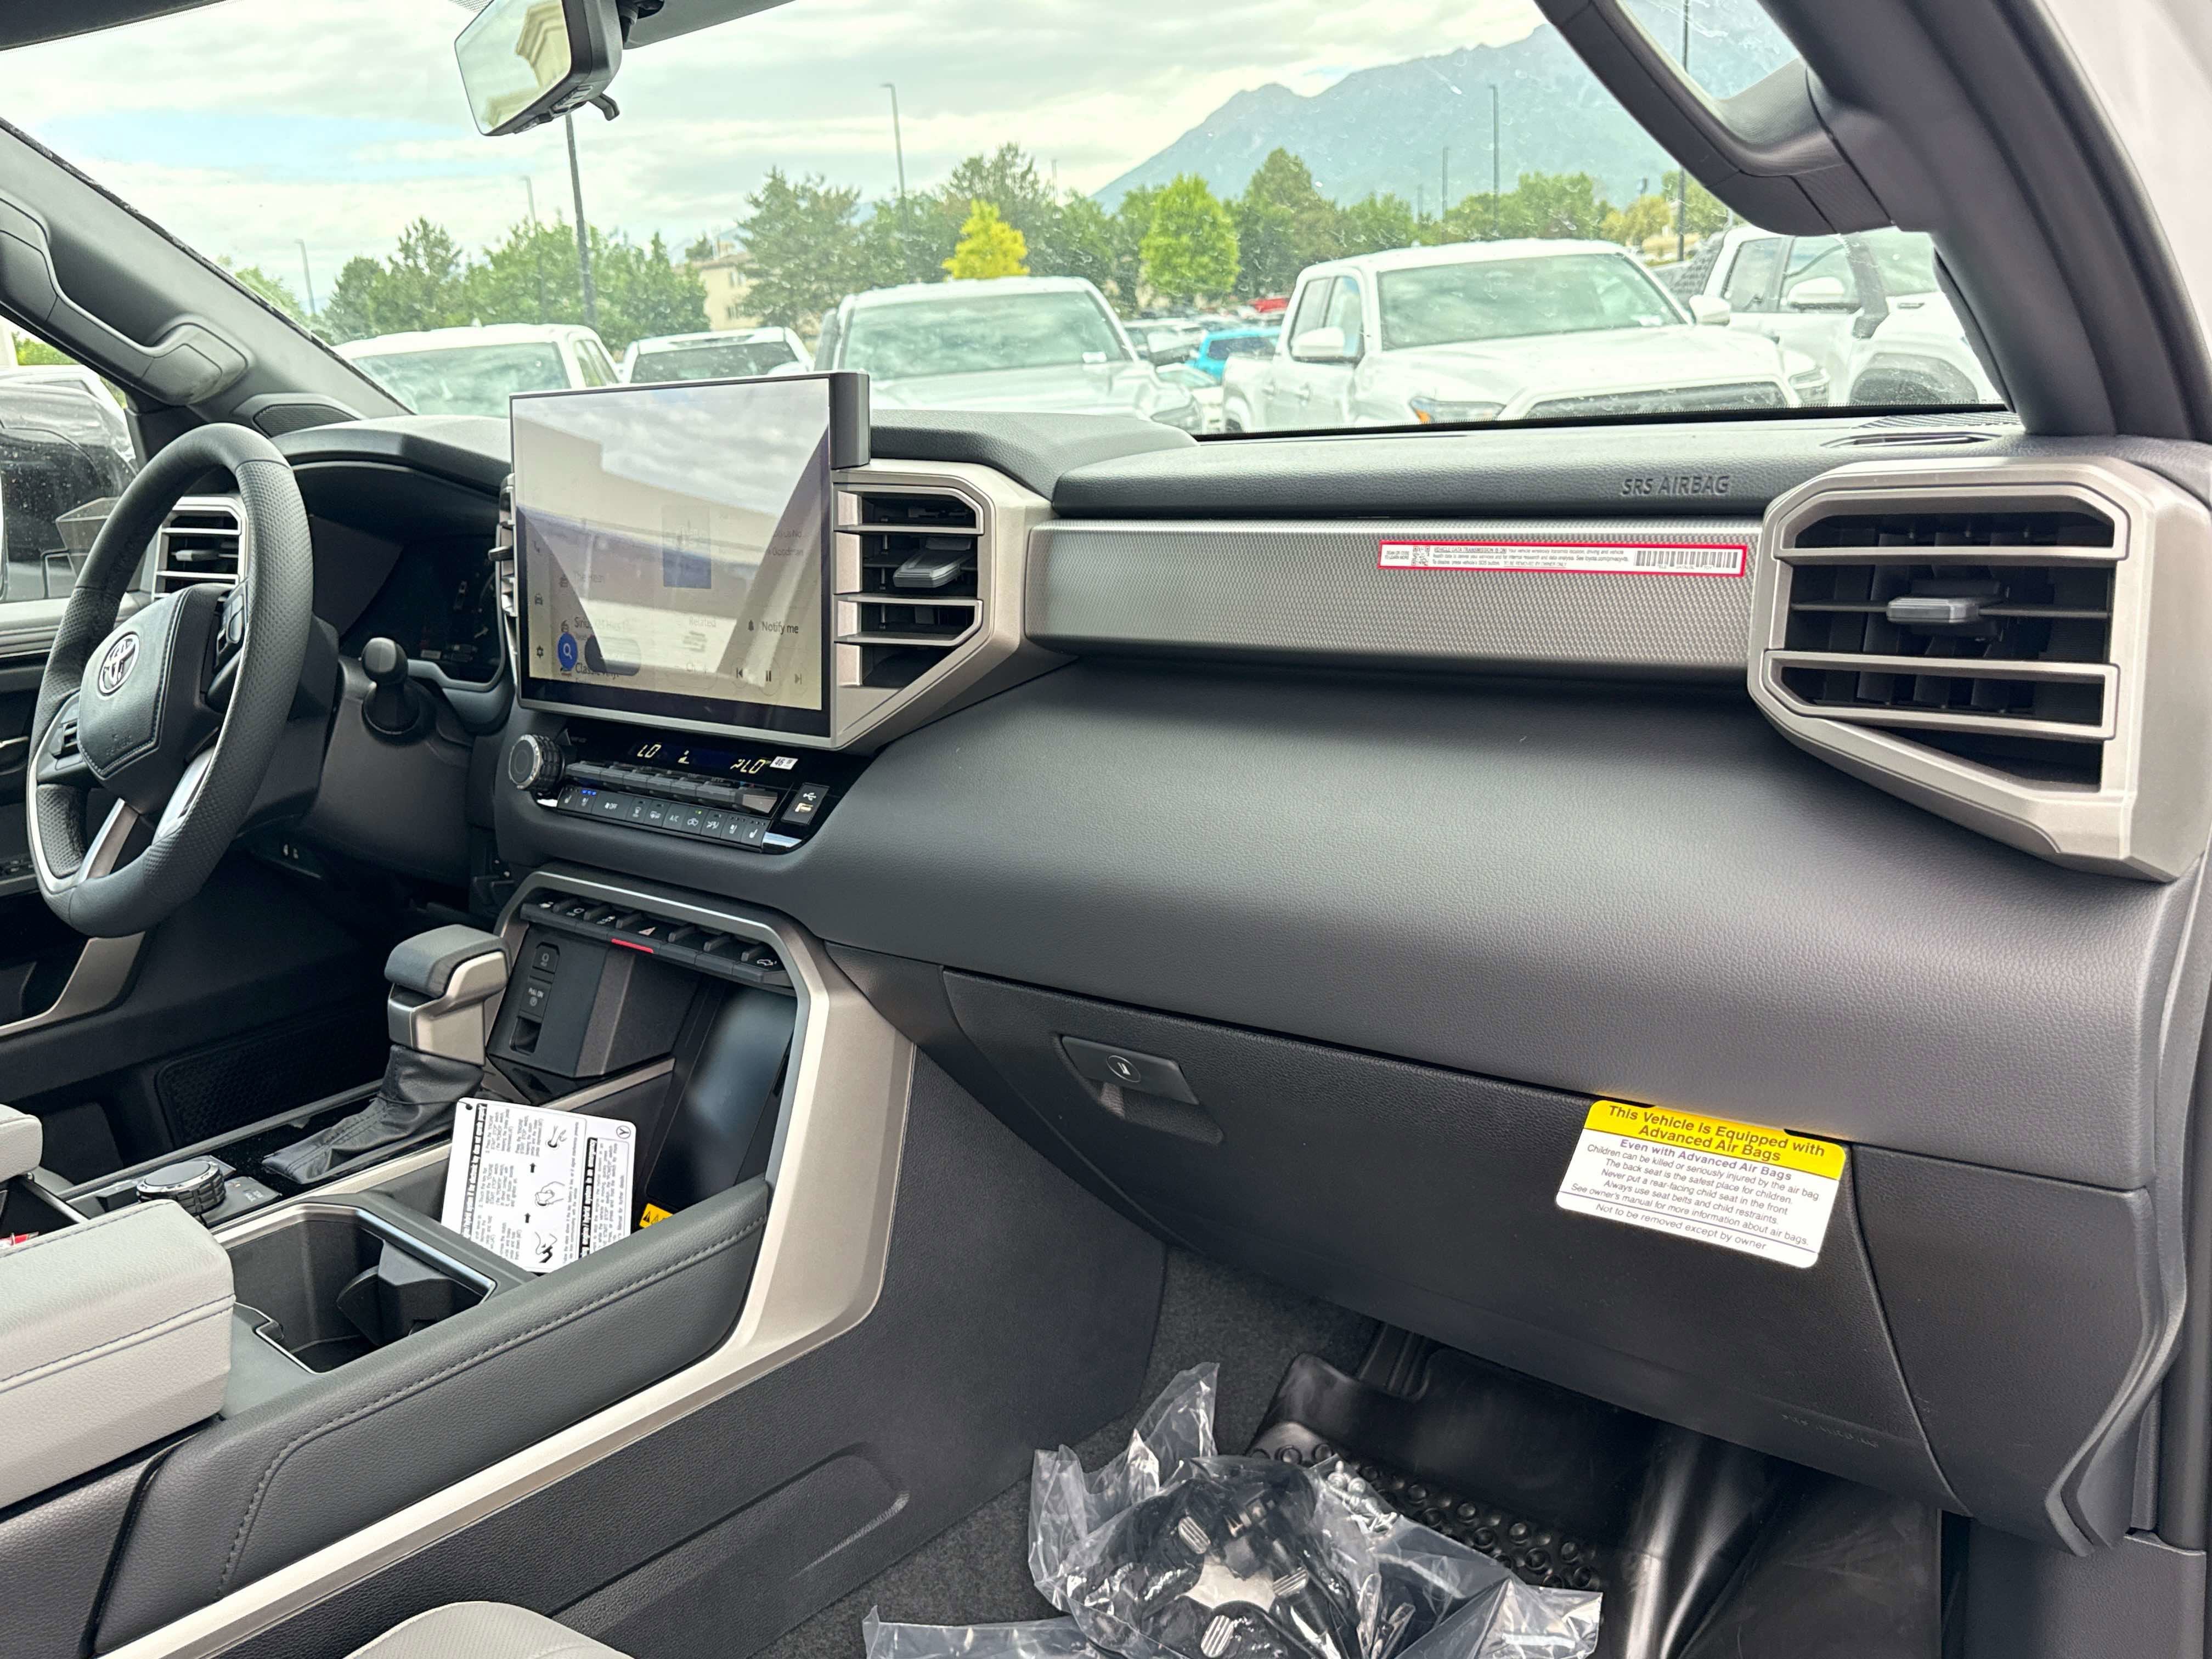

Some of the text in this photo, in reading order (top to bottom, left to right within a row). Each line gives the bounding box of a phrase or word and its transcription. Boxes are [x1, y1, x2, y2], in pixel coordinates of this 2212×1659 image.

[1622, 476, 1729, 494] SRS AIRBAG
[761, 620, 799, 635] Notify me
[1610, 1105, 1638, 1120] This
[1644, 1112, 1694, 1131] Vehicle
[1716, 1126, 1788, 1148] Equipped
[1793, 1142, 1825, 1156] with
[1639, 1125, 1780, 1162] Advanced Air Bags
[1587, 1144, 1621, 1157] Children
[1639, 1154, 1650, 1163] be
[1652, 1157, 1674, 1168] killed
[1686, 1165, 1724, 1179] seriously
[1726, 1172, 1757, 1184] injured
[1758, 1178, 1769, 1188] by
[1771, 1181, 1785, 1190] the
[1606, 1158, 1621, 1168] The
[1622, 1162, 1642, 1172] back
[1644, 1168, 1662, 1176] seat
[1673, 1173, 1687, 1181] the
[1689, 1177, 1714, 1187] safest
[1716, 1182, 1740, 1192] place
[1742, 1186, 1754, 1194] for
[1620, 1139, 1791, 1181] Even with Advanced Air Bags
[1601, 1169, 1626, 1180] Never
[1650, 1180, 1695, 1195] rear-facing
[1696, 1189, 1717, 1199] child
[1719, 1193, 1738, 1203] seat
[1750, 1199, 1765, 1209] the
[1604, 1180, 1633, 1192] Always
[1652, 1191, 1671, 1200] seat
[1672, 1194, 1692, 1204] belts
[1694, 1200, 1712, 1208] and
[1713, 1203, 1734, 1213] child
[1571, 1183, 1588, 1193] See
[1589, 1189, 1620, 1200] owner's
[1622, 1195, 1653, 1207] manual
[1654, 1201, 1666, 1209] for
[1668, 1205, 1690, 1215] more
[1691, 1210, 1740, 1226] information
[1742, 1222, 1768, 1233] about
[1770, 1229, 1782, 1237] air
[1596, 1204, 1613, 1213] Not
[1626, 1210, 1639, 1219] be
[1641, 1215, 1683, 1229] removed
[1685, 1225, 1718, 1237] except
[1720, 1231, 1733, 1243] by
